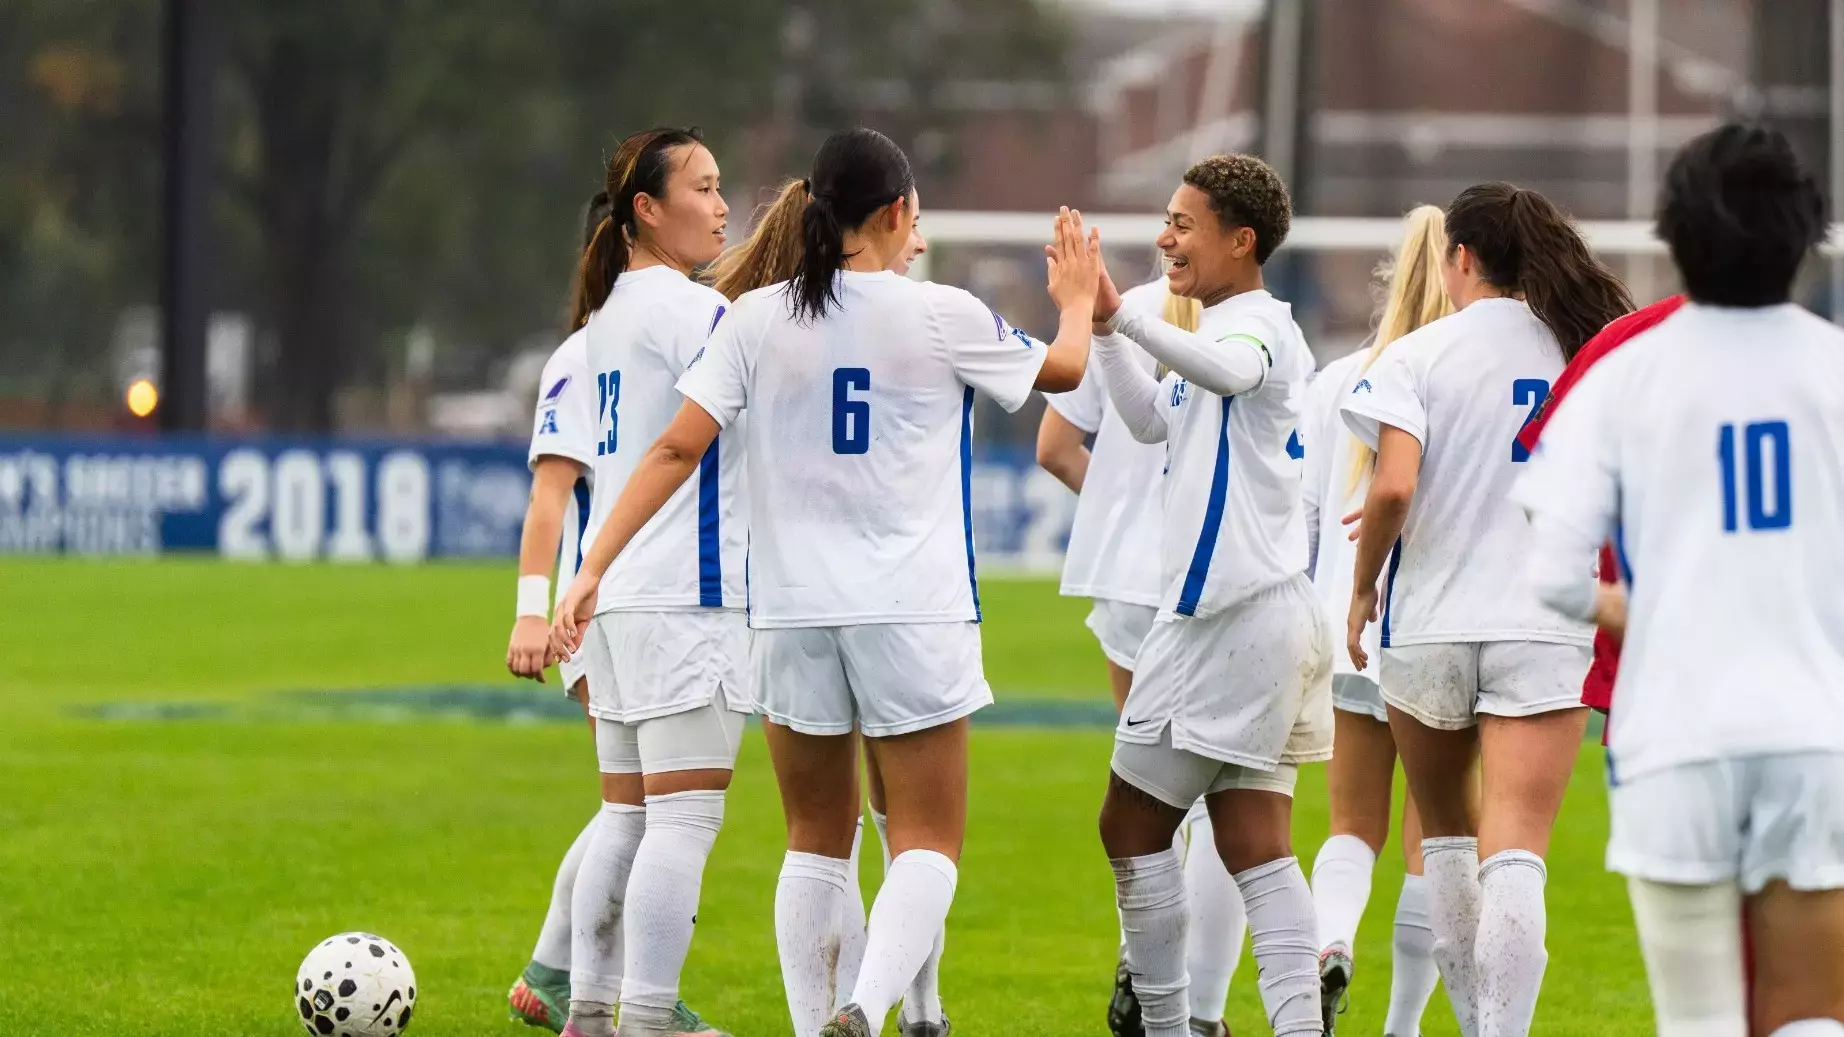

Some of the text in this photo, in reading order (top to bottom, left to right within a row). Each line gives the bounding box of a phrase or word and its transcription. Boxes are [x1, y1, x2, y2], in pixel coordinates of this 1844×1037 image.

[832, 367, 870, 454] 6
[218, 448, 430, 562] 2018
[1718, 421, 1792, 532] 10
